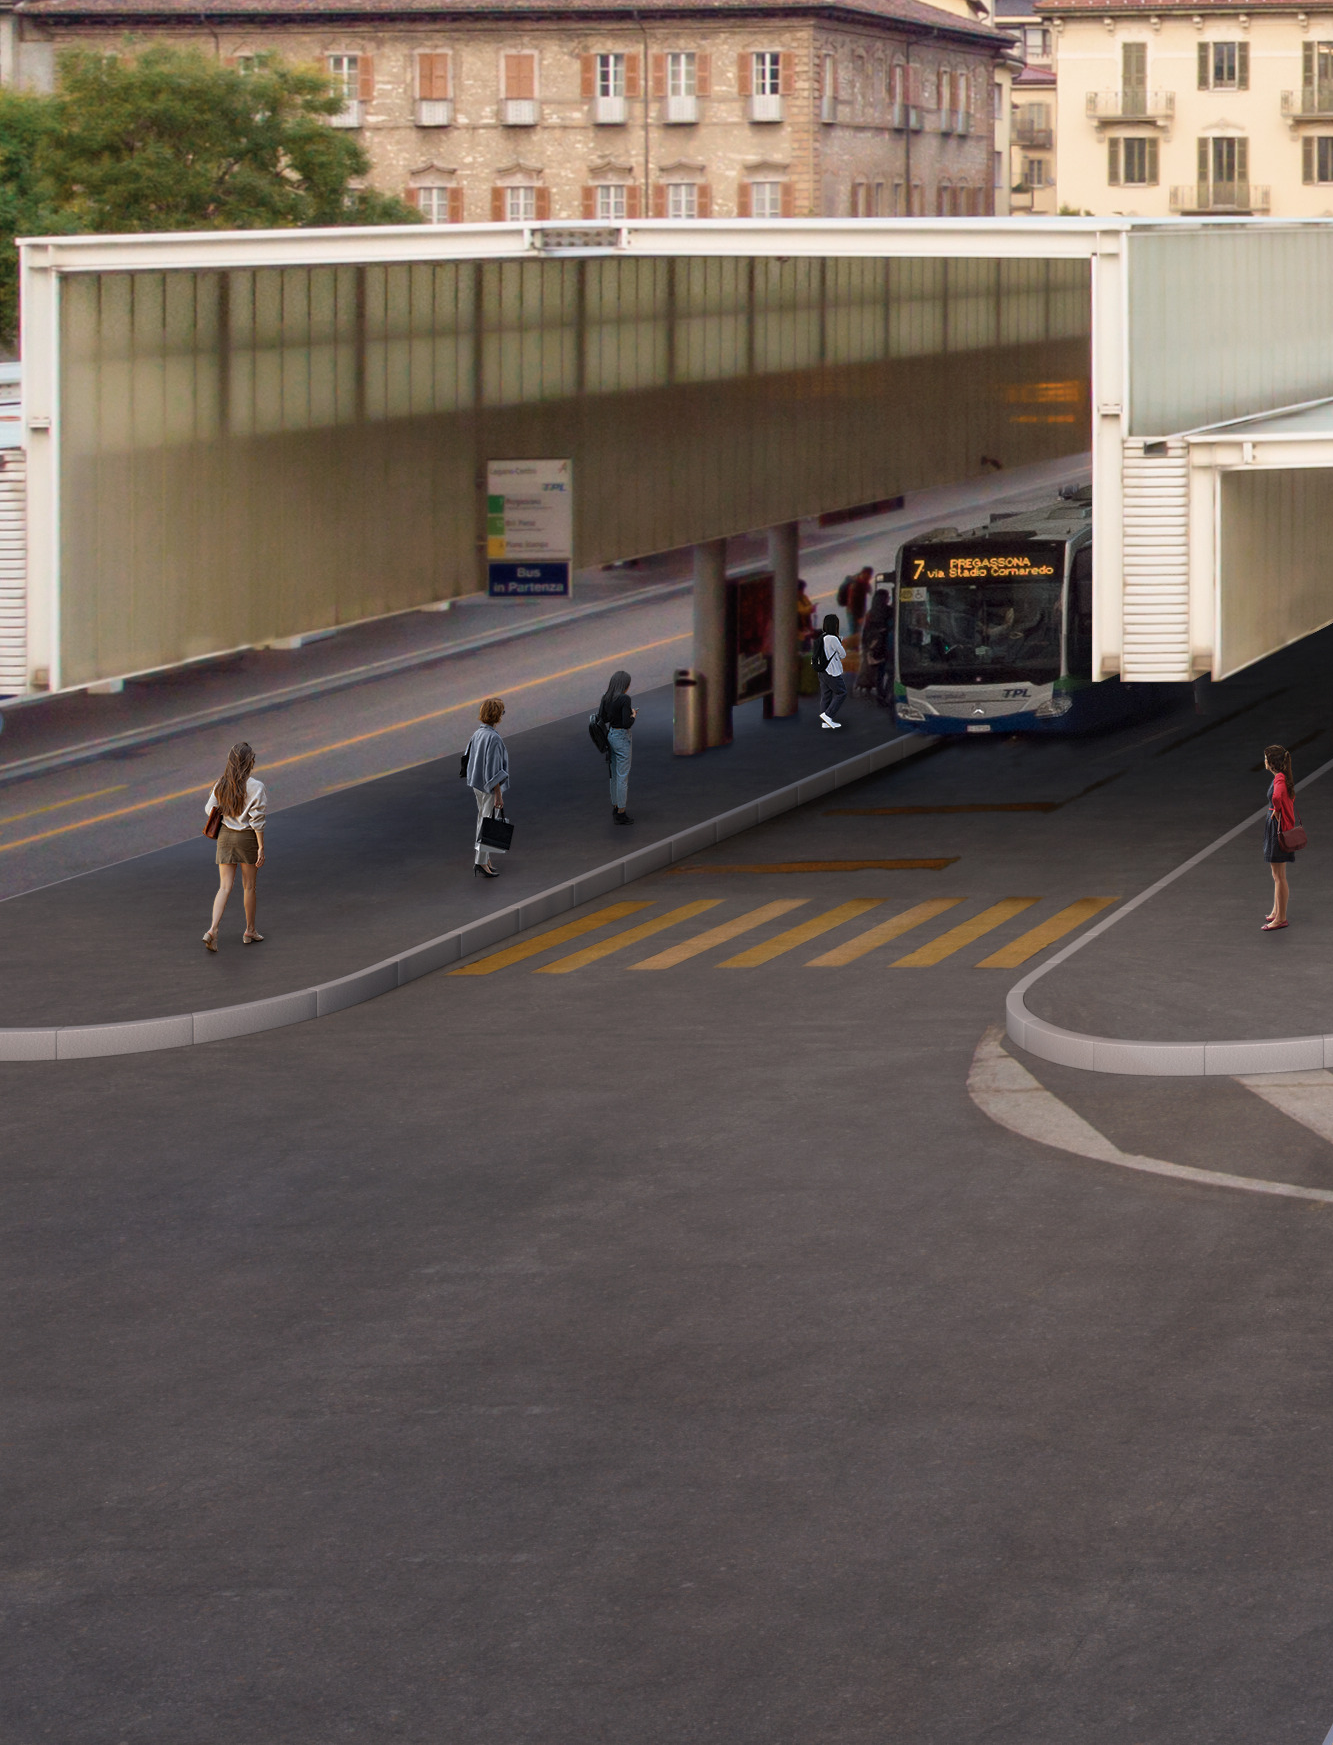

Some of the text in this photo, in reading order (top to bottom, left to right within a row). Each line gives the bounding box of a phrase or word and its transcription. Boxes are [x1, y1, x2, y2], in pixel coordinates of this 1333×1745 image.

[949, 557, 1031, 569] PREGASSONA
[517, 567, 541, 578] Bus
[913, 559, 926, 580] 7
[926, 564, 1054, 578] via Stadio Cornaredo
[493, 582, 564, 593] in Partenza
[1003, 688, 1032, 698] TPL
